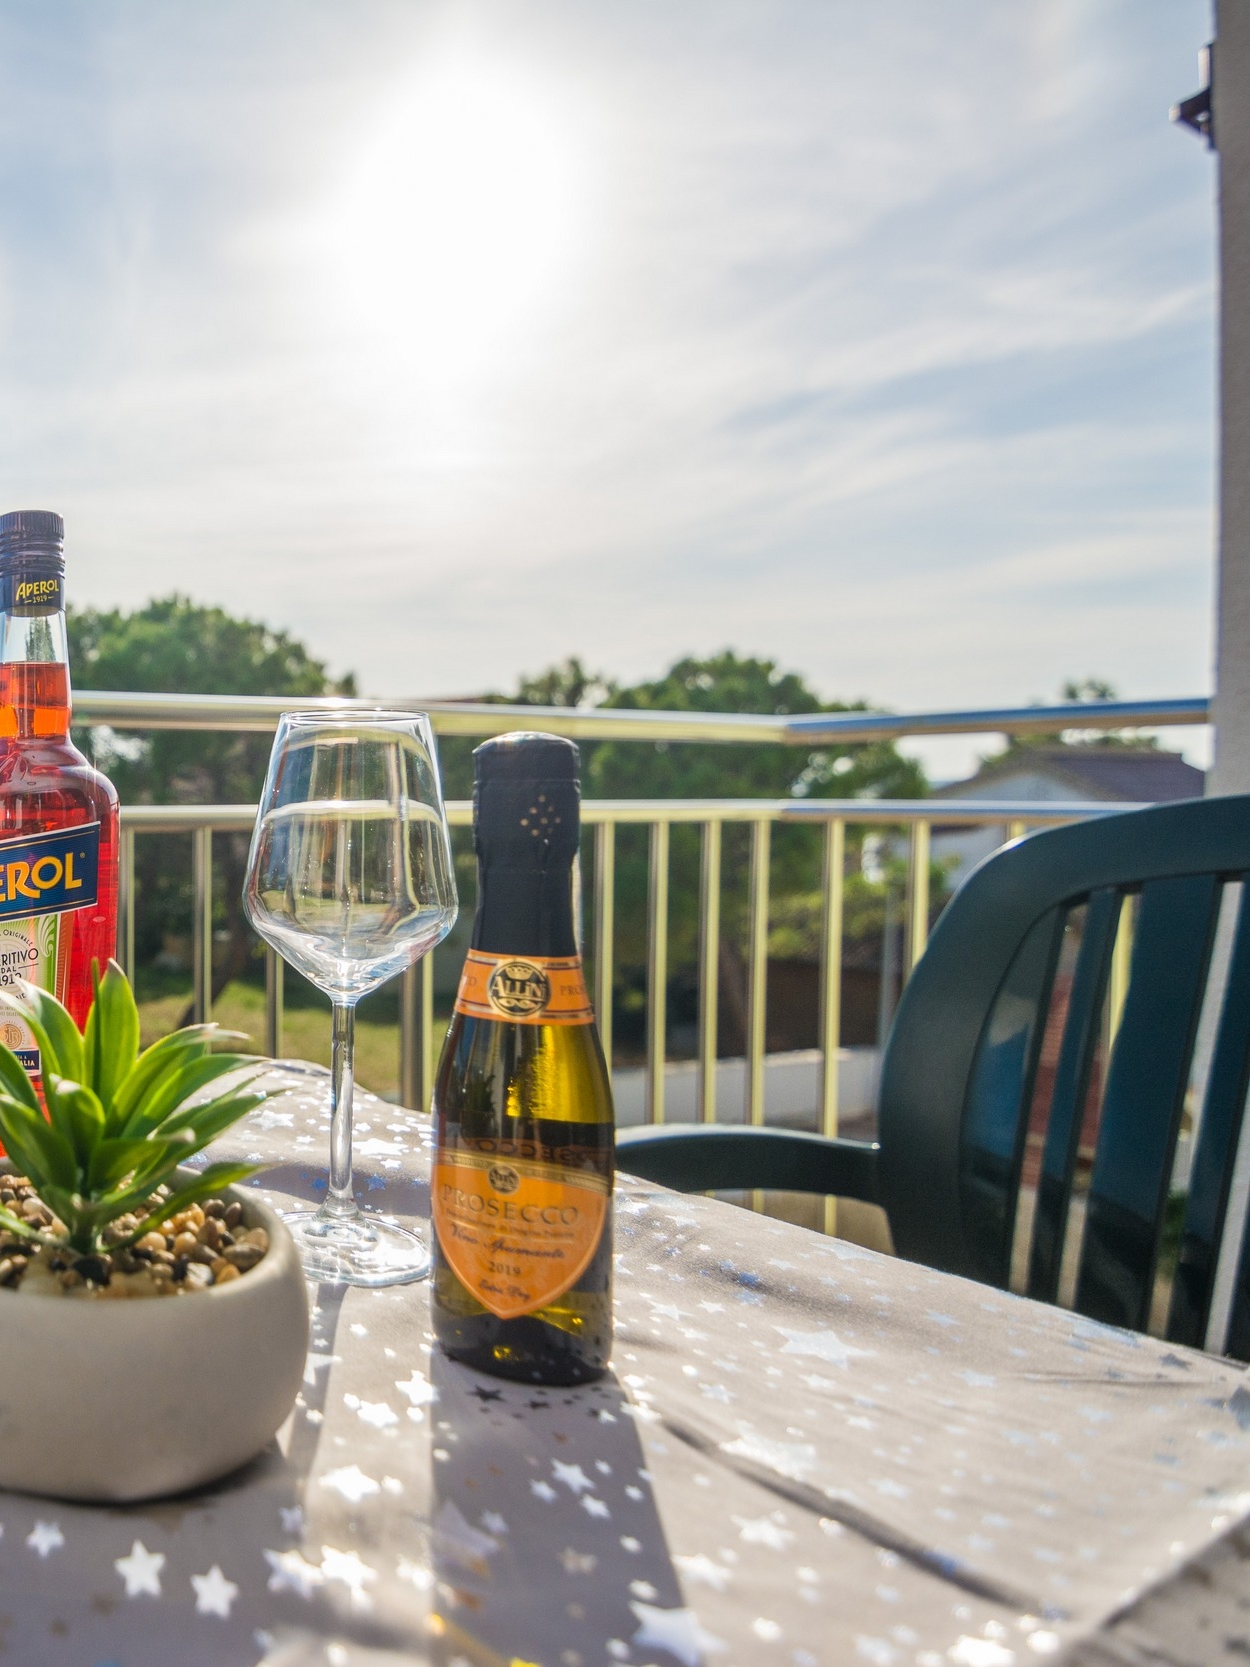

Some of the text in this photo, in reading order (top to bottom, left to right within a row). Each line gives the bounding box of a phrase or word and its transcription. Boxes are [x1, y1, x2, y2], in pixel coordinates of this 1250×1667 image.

[16, 580, 59, 601] APEROL
[32, 595, 48, 603] 1919
[2, 929, 33, 947] ORIGINALE
[0, 966, 17, 974] DAL
[443, 1184, 579, 1226] PROSECCO
[488, 1260, 522, 1276] 2019
